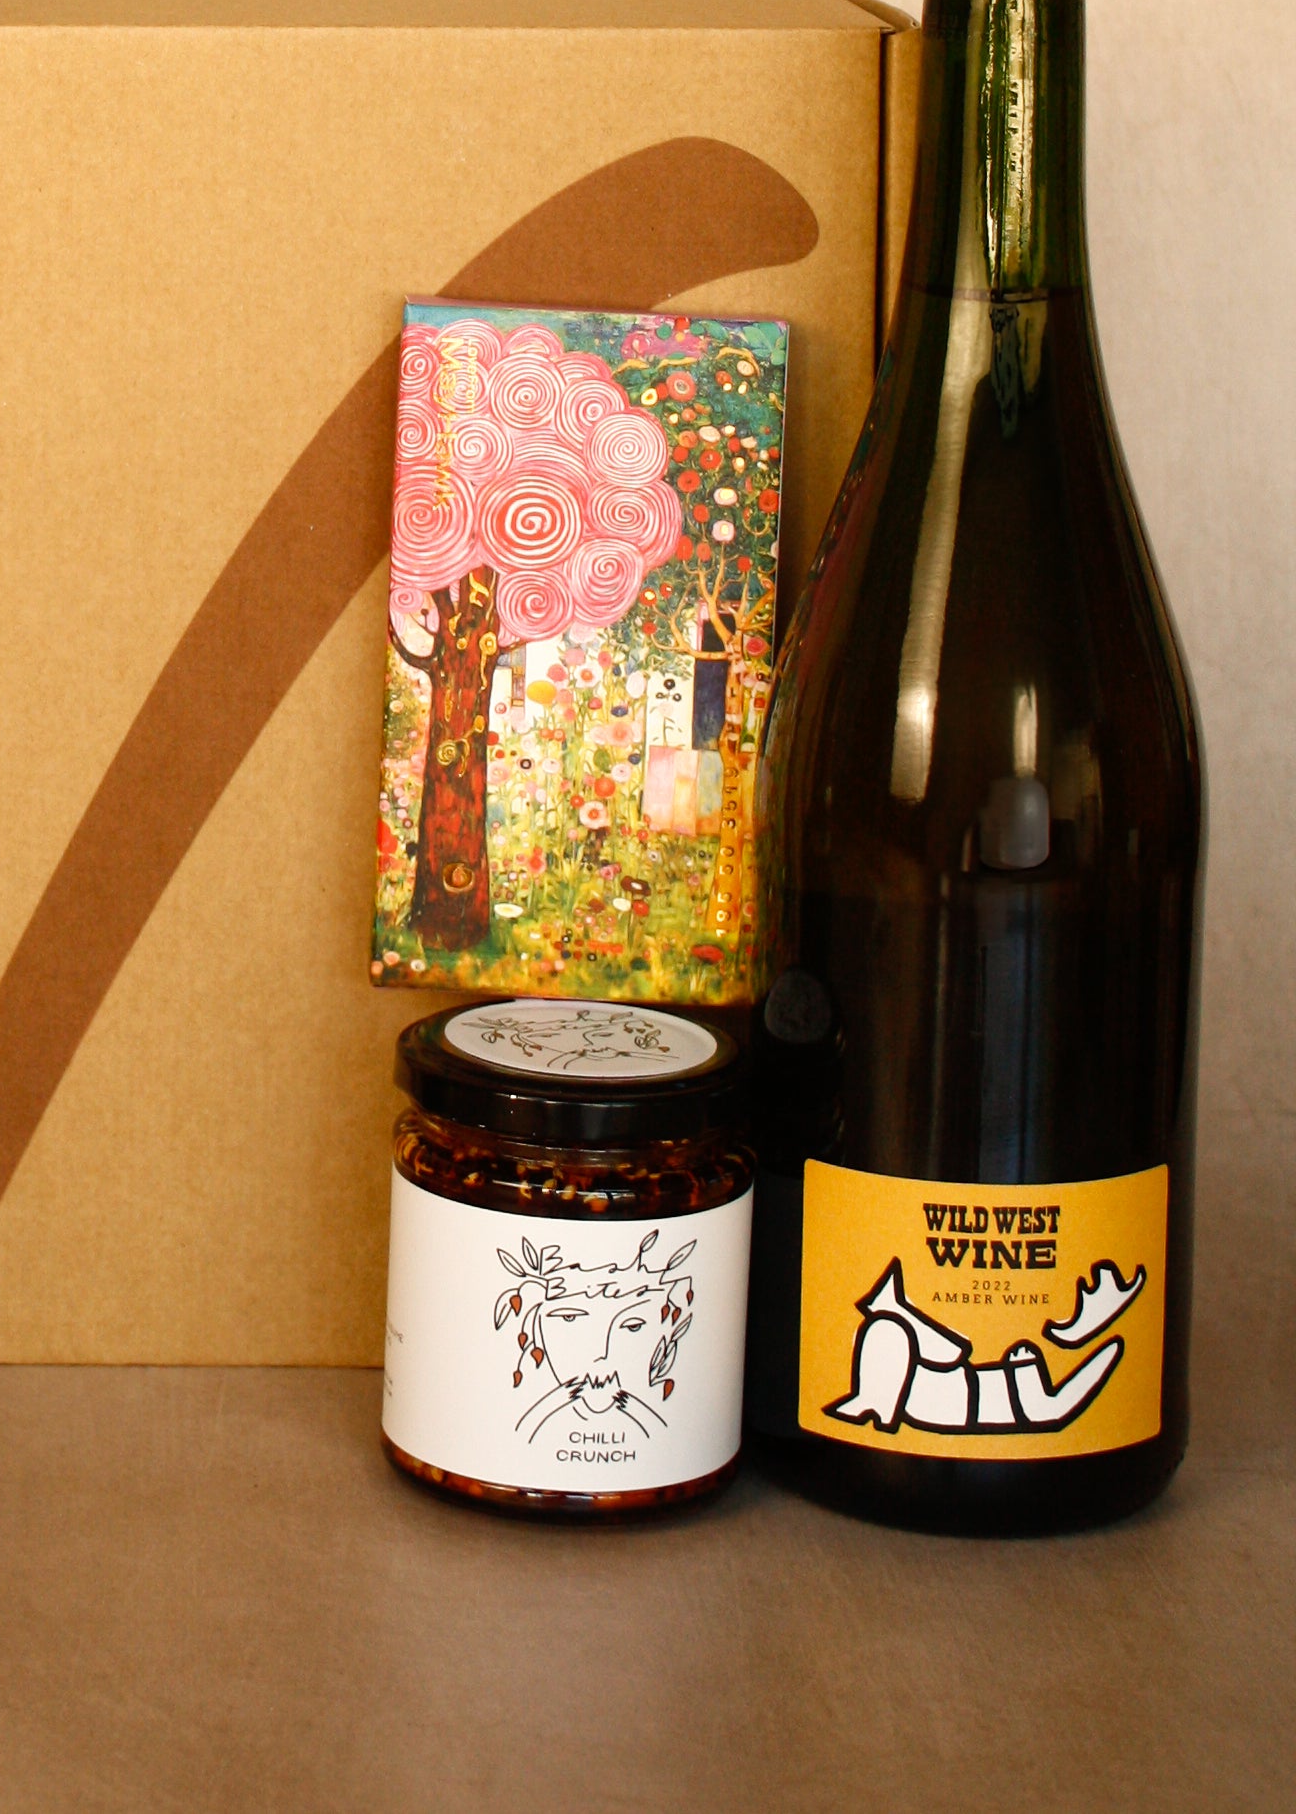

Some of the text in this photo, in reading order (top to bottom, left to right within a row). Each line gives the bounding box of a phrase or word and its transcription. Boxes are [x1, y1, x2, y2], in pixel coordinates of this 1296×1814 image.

[923, 1203, 1060, 1234] WILD WEST
[926, 1237, 1056, 1269] WINE
[972, 1280, 1011, 1291] 2022
[932, 1292, 1049, 1305] AMBER WINE
[569, 1431, 626, 1444] CHILLI
[556, 1449, 636, 1463] CRUNCH
